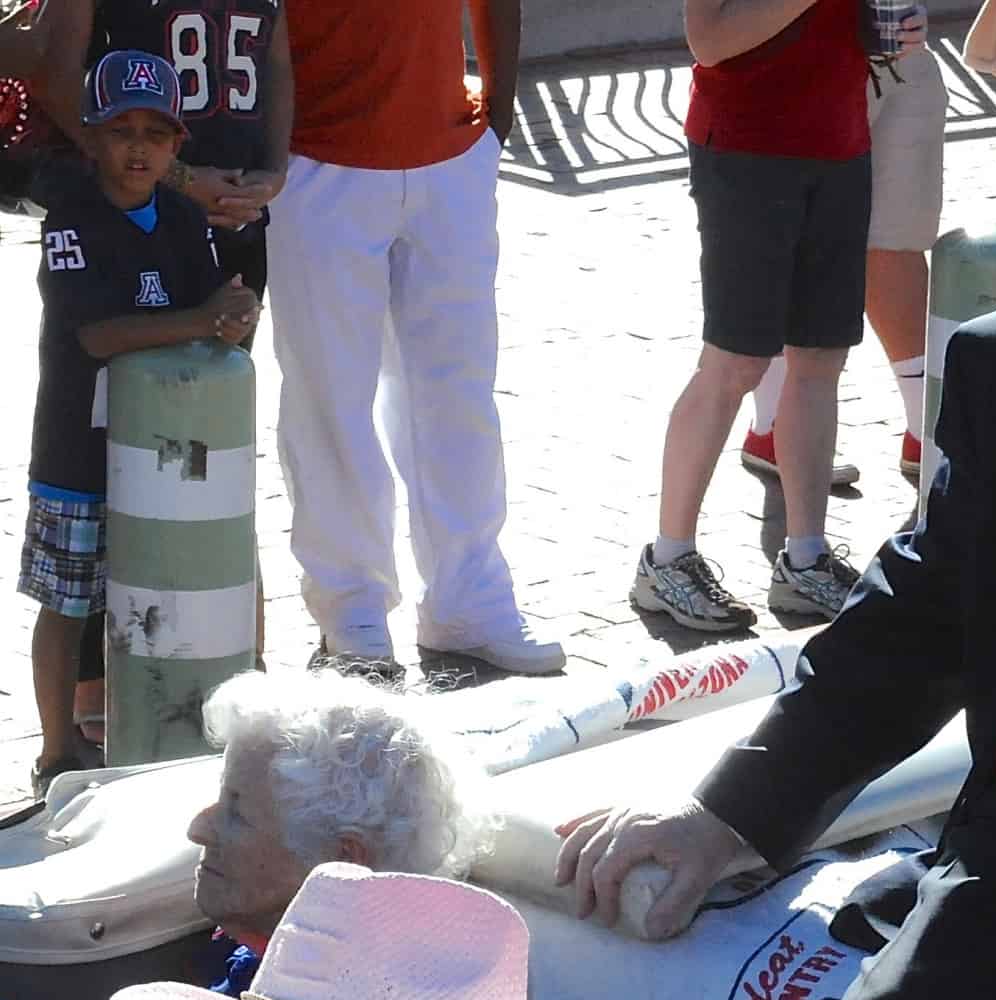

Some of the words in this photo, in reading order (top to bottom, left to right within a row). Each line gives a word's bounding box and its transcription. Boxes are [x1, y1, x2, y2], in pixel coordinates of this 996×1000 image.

[122, 59, 164, 95] A
[171, 14, 262, 111] 85
[46, 230, 86, 271] 25
[135, 271, 170, 307] A
